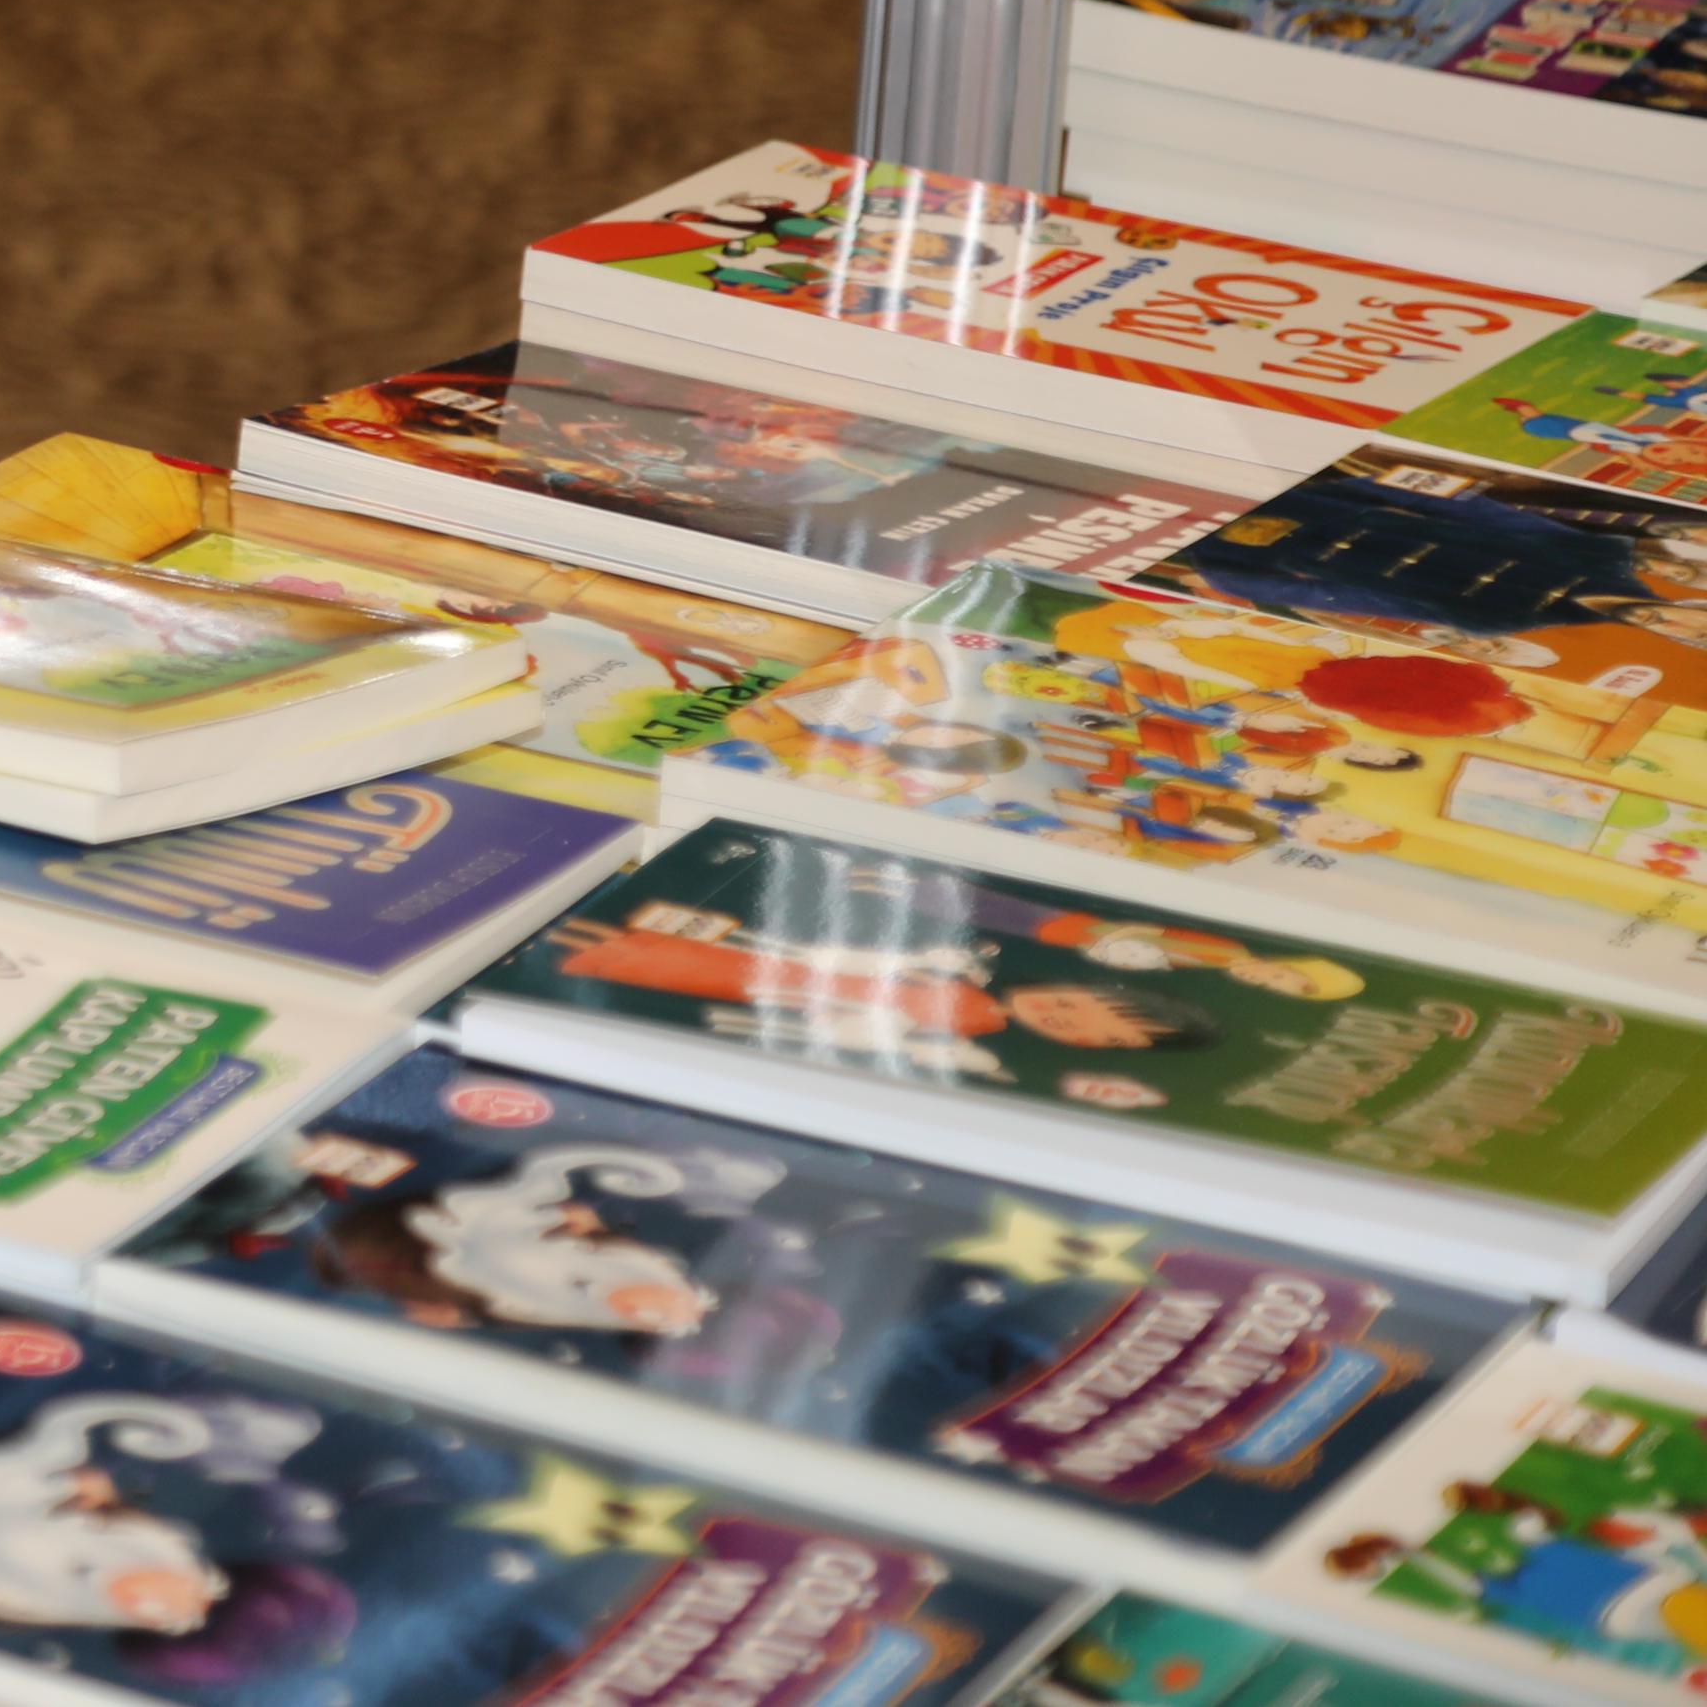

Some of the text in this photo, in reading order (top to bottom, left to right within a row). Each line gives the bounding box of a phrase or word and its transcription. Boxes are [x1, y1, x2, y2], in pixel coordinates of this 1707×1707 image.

[1037, 256, 1169, 320] Çılgın Proje
[1099, 271, 1321, 354] Okul
[1259, 294, 1516, 386] Çılgın
[72, 1000, 220, 1105] PATEN
[1011, 1289, 1225, 1437] YILDIZLAR
[1177, 1271, 1331, 1391] GÖZLÜK
